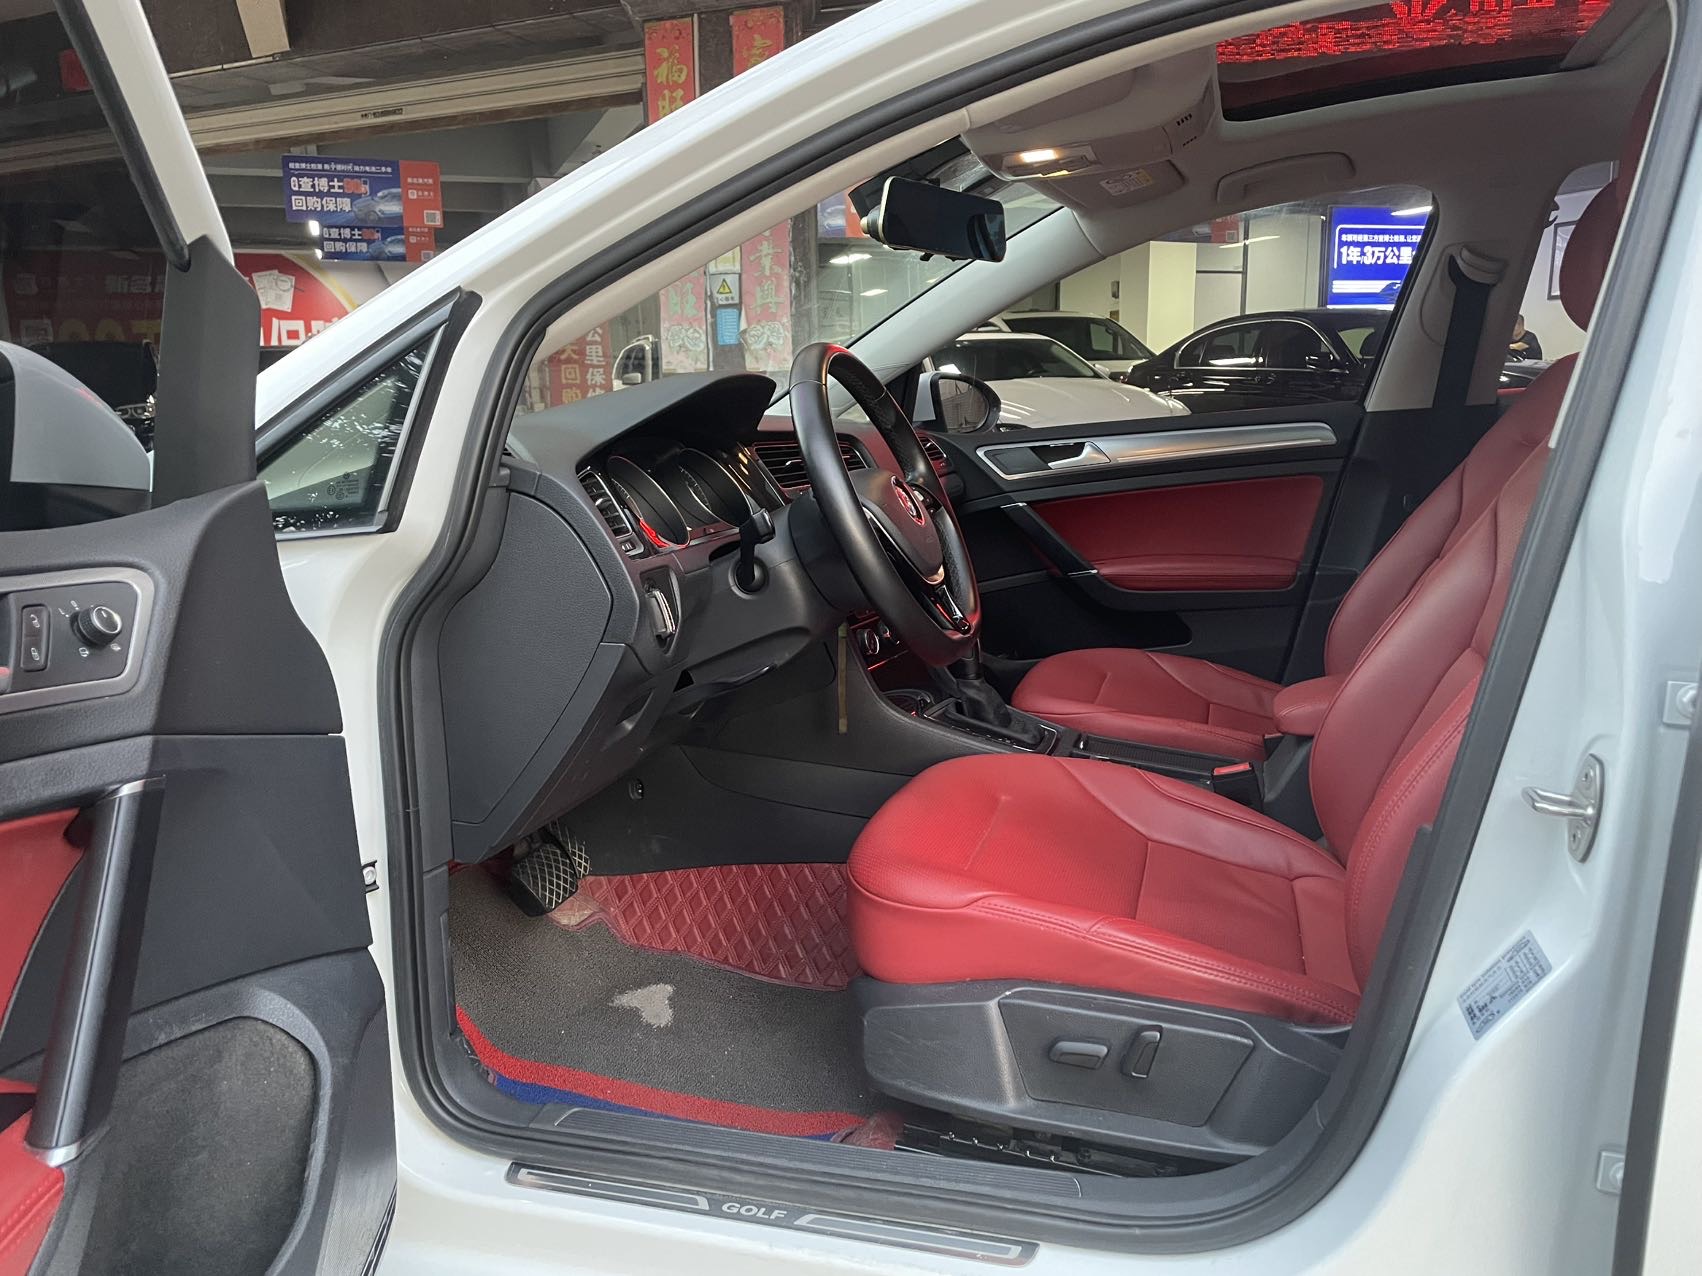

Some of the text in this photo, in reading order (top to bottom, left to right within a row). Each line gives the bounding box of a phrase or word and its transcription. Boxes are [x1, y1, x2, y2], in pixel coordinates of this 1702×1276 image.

[291, 195, 352, 212] 回购保障
[323, 241, 368, 252] 回购保障
[1340, 245, 1415, 265] 1年/3万公里
[721, 1202, 788, 1220] GOLF
